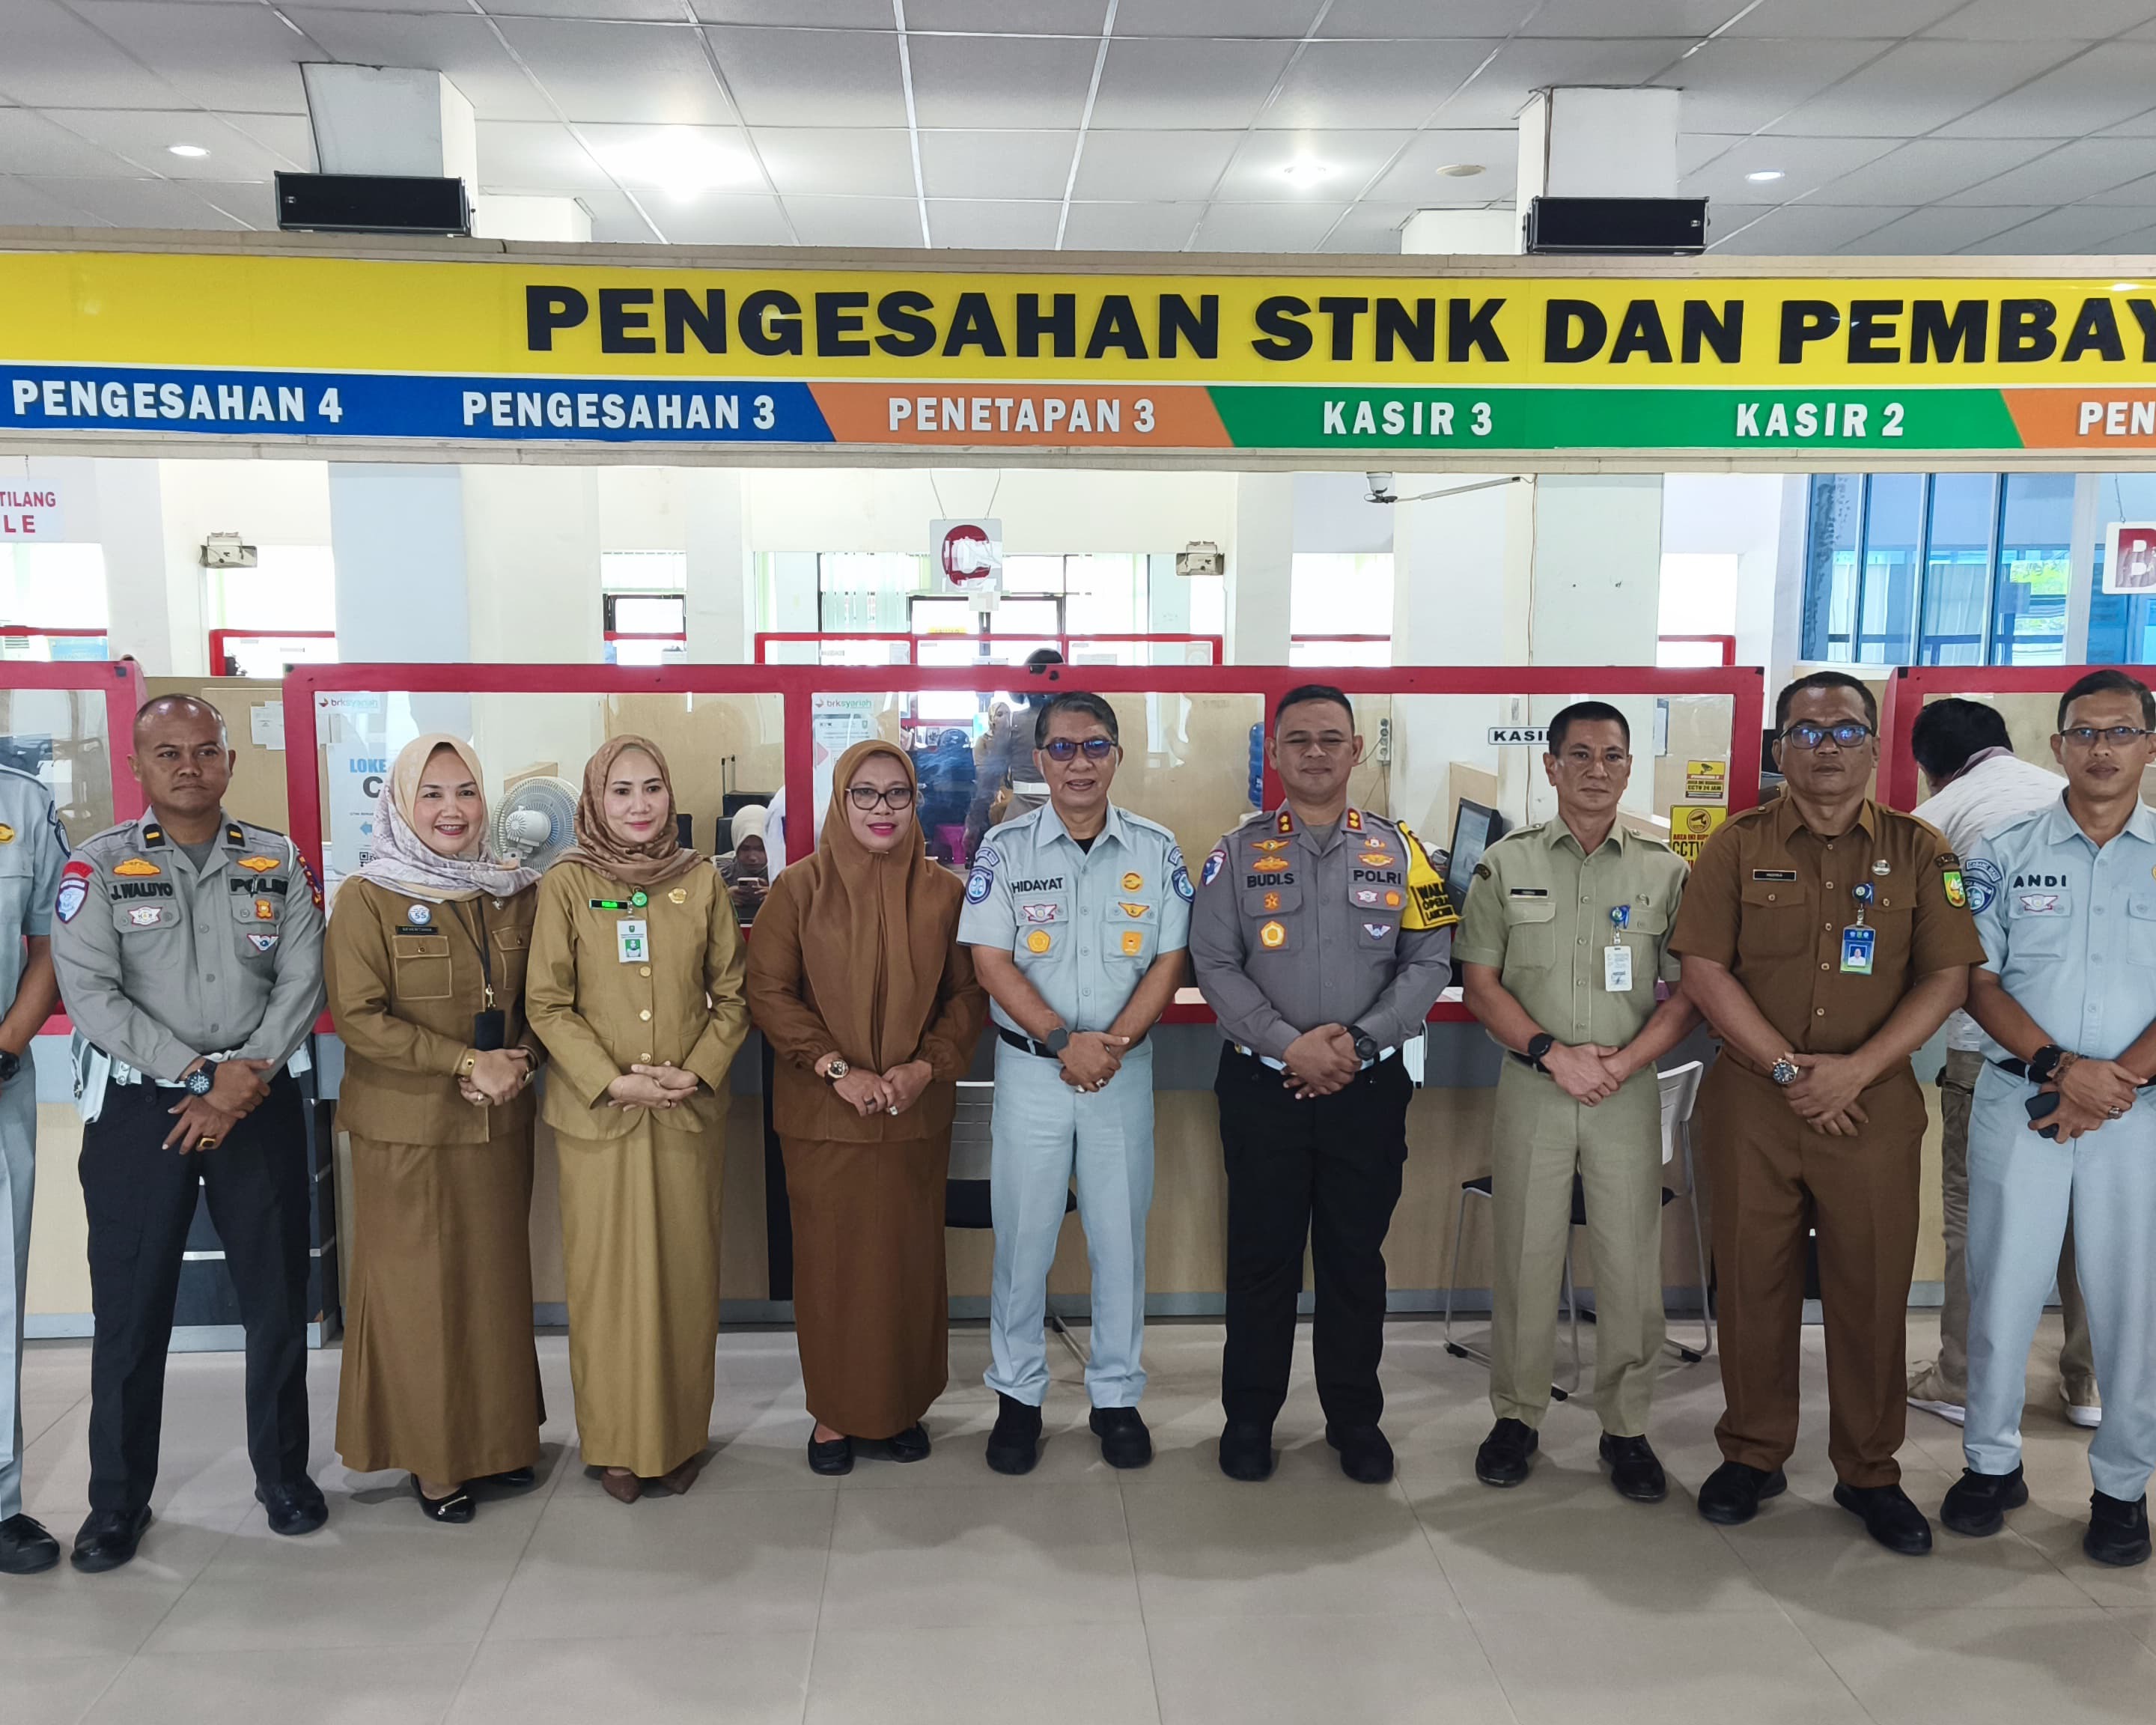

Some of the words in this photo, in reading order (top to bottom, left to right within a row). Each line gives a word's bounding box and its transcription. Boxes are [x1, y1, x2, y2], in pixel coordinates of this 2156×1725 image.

[526, 285, 1219, 359] PENGESAHAN
[1251, 295, 1509, 363] STNK
[1544, 299, 1744, 364] DAN
[1779, 297, 2156, 364] PEMBAY
[12, 380, 305, 422] PENGESAHAN
[318, 388, 343, 423] 4
[463, 391, 740, 429] PENGESAHAN
[753, 395, 776, 430] 3
[889, 397, 1120, 432] PENETAPAN
[1133, 398, 1155, 433] 3
[1324, 401, 1455, 436] KASIR
[1471, 402, 1492, 436] 3
[1736, 403, 1868, 437] KASIR
[1882, 403, 1904, 436] 2
[0, 491, 56, 508] TILANG
[350, 758, 387, 773] LOKE
[1011, 877, 1063, 894] HIDAYAT
[1353, 870, 1401, 885] POLRI
[2013, 874, 2066, 889] ANDI
